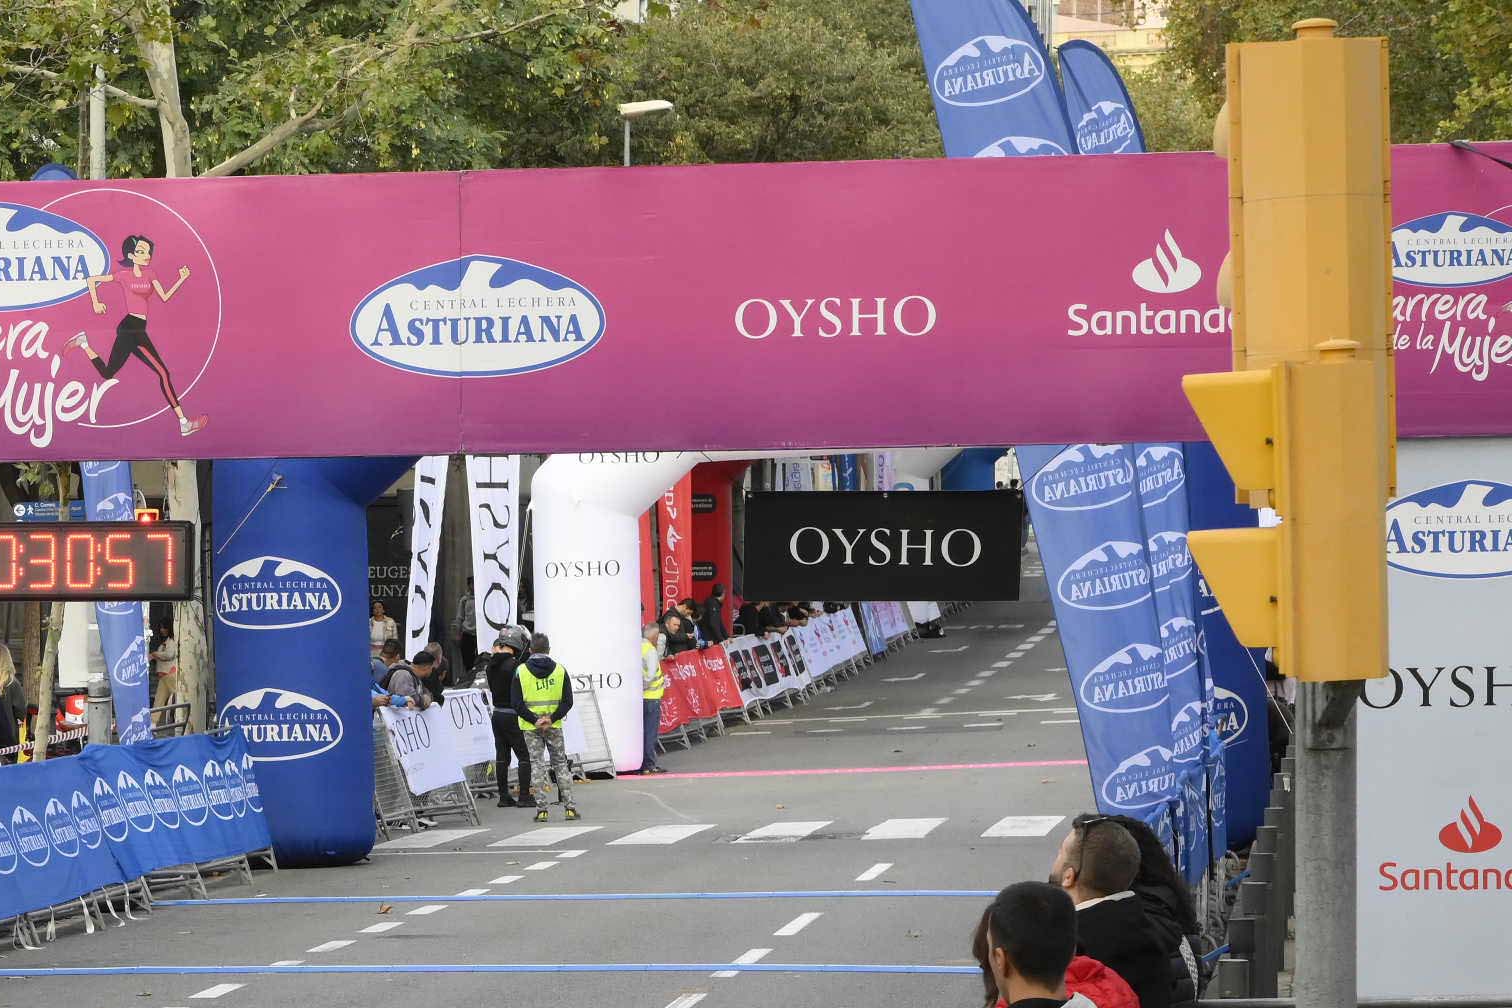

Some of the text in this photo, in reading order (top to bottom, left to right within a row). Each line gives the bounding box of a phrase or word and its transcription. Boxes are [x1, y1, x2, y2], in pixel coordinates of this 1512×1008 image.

[13, 239, 84, 250] LECHERA
[410, 296, 576, 310] CENTRAL LECHERA
[370, 303, 586, 347] ASTURIANA
[734, 296, 937, 338] OYSHO
[1417, 322, 1434, 350] la
[1430, 317, 1512, 382] Muje
[1414, 515, 1481, 525] CENTRAL
[789, 526, 982, 567] OYSHO
[545, 560, 621, 579] OYSHO
[233, 580, 328, 590] CENTRAL LECHERA
[220, 586, 332, 613] ASTURIANA
[535, 677, 556, 692] Life
[575, 672, 622, 690] SHO
[1360, 665, 1512, 709] OYSH
[234, 712, 328, 721] CENTRAL LECHERA
